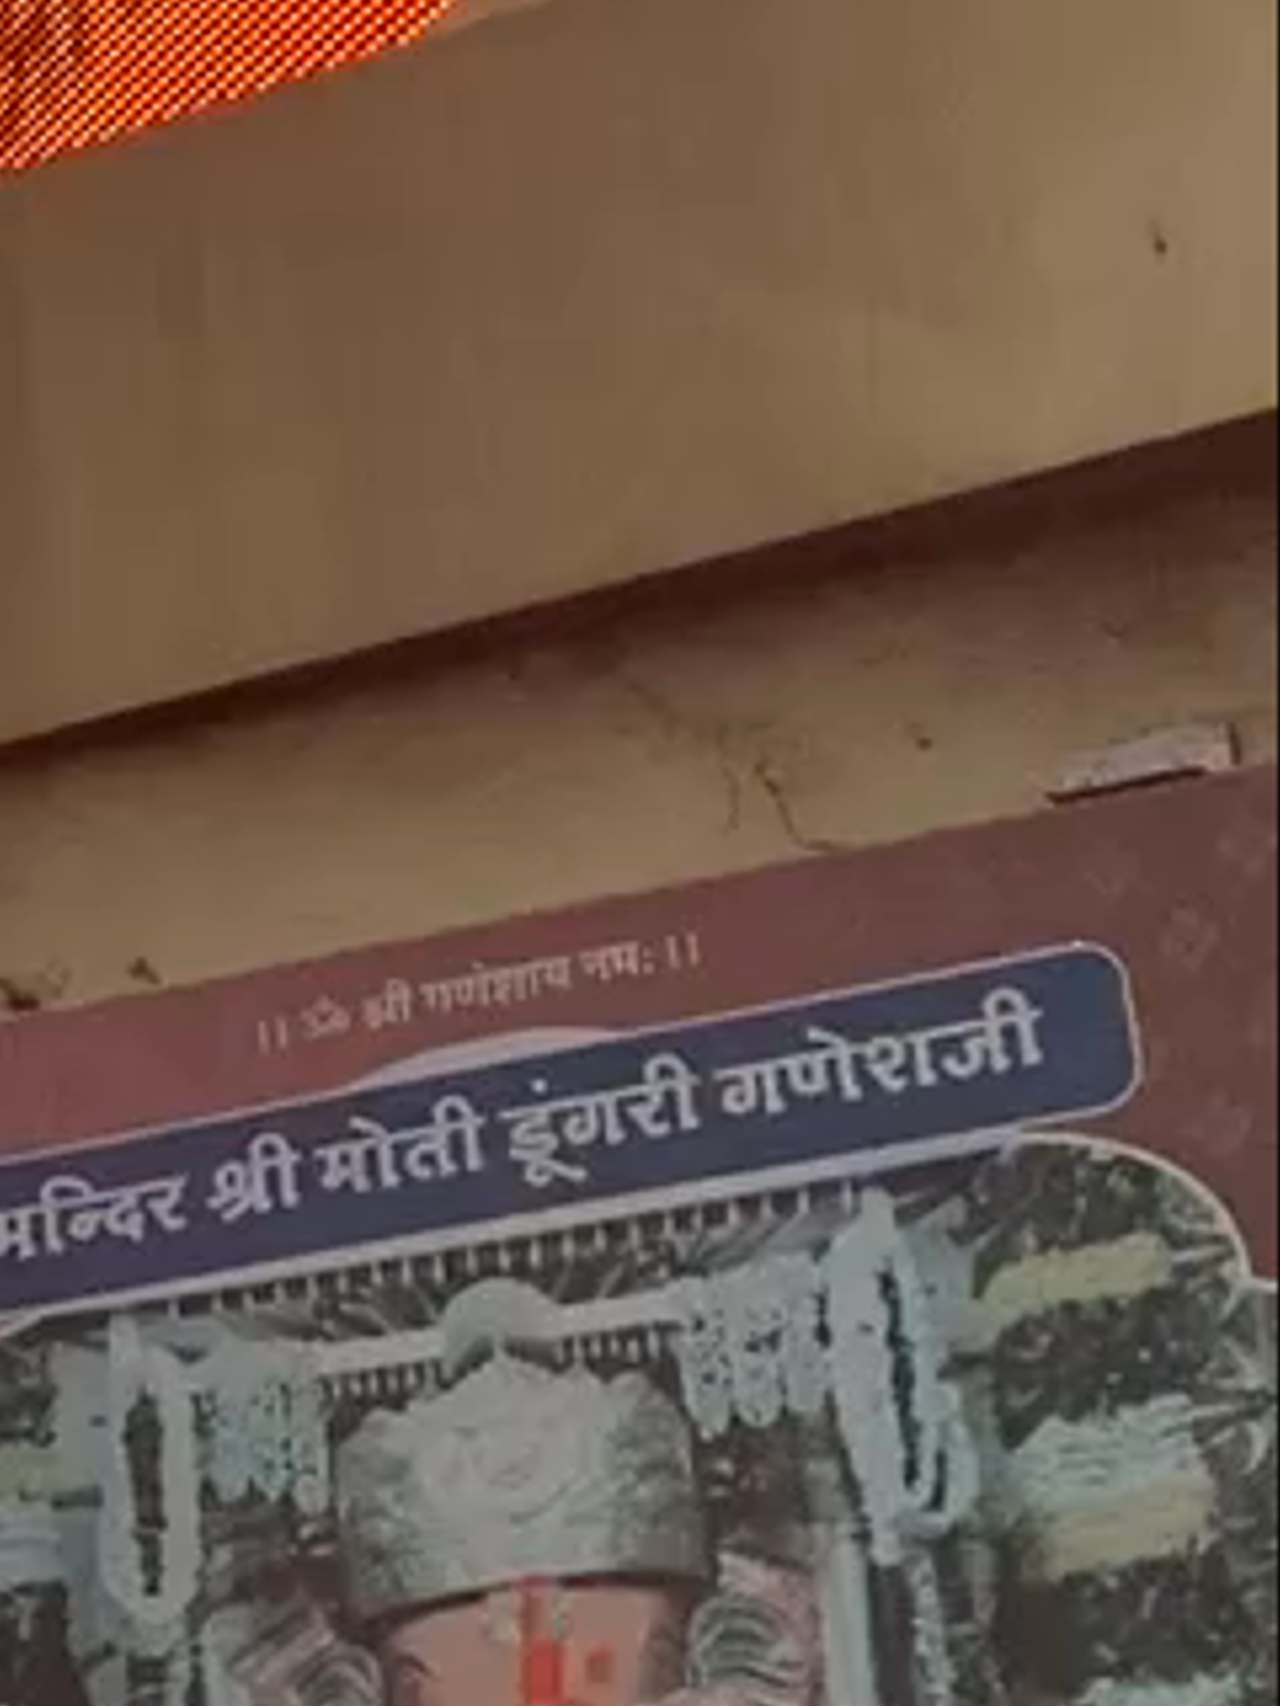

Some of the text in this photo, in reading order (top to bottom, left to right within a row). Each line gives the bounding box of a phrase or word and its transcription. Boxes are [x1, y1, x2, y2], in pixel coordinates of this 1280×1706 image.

[364, 977, 411, 1029] श्री
[207, 1132, 303, 1222] श्री
[314, 1095, 486, 1192] मोती
[498, 1055, 703, 1186] डूंगरी
[715, 987, 1043, 1116] गणेशजी
